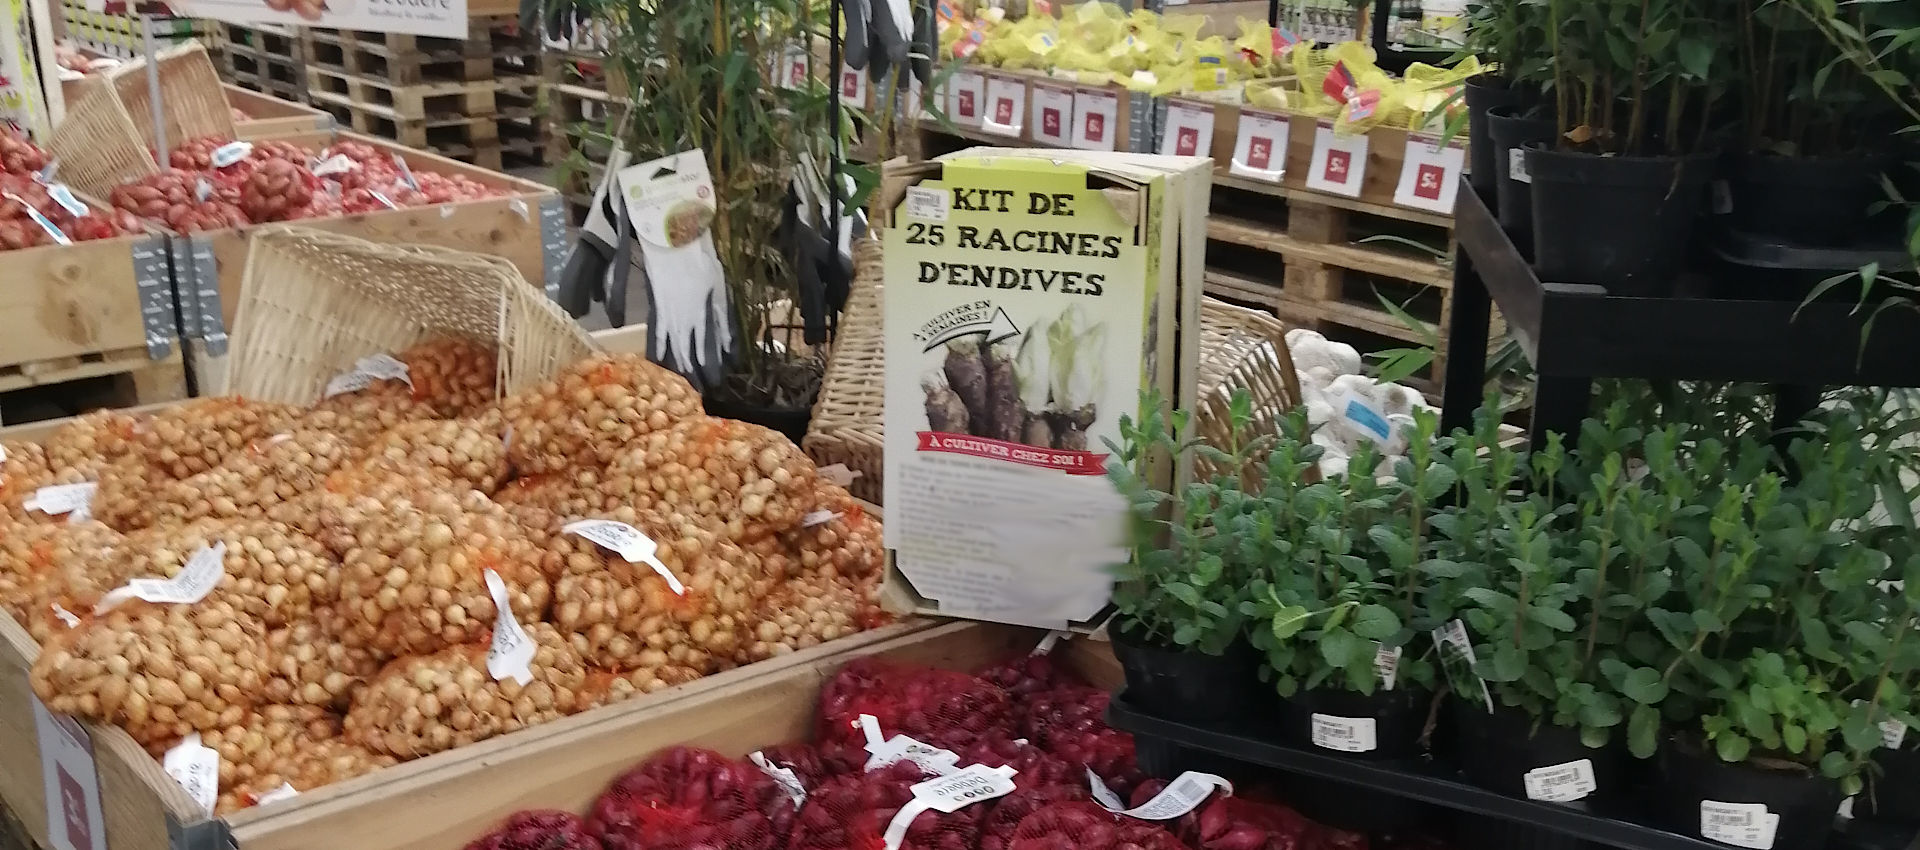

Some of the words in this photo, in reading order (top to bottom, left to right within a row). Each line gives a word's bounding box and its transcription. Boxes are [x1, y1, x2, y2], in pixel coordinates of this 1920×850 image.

[953, 188, 1014, 212] KIT
[1027, 192, 1075, 216] DE
[906, 223, 945, 247] 25
[957, 225, 1122, 259] RACINES
[918, 261, 1105, 296] D'ENDIVES
[974, 299, 991, 311] EN
[928, 313, 981, 336] SEMAINES
[929, 434, 942, 448] À
[943, 438, 1009, 457] CULTIVER
[1012, 450, 1049, 464] CHEZ
[1052, 455, 1075, 466] SOI
[1078, 454, 1084, 467] !
